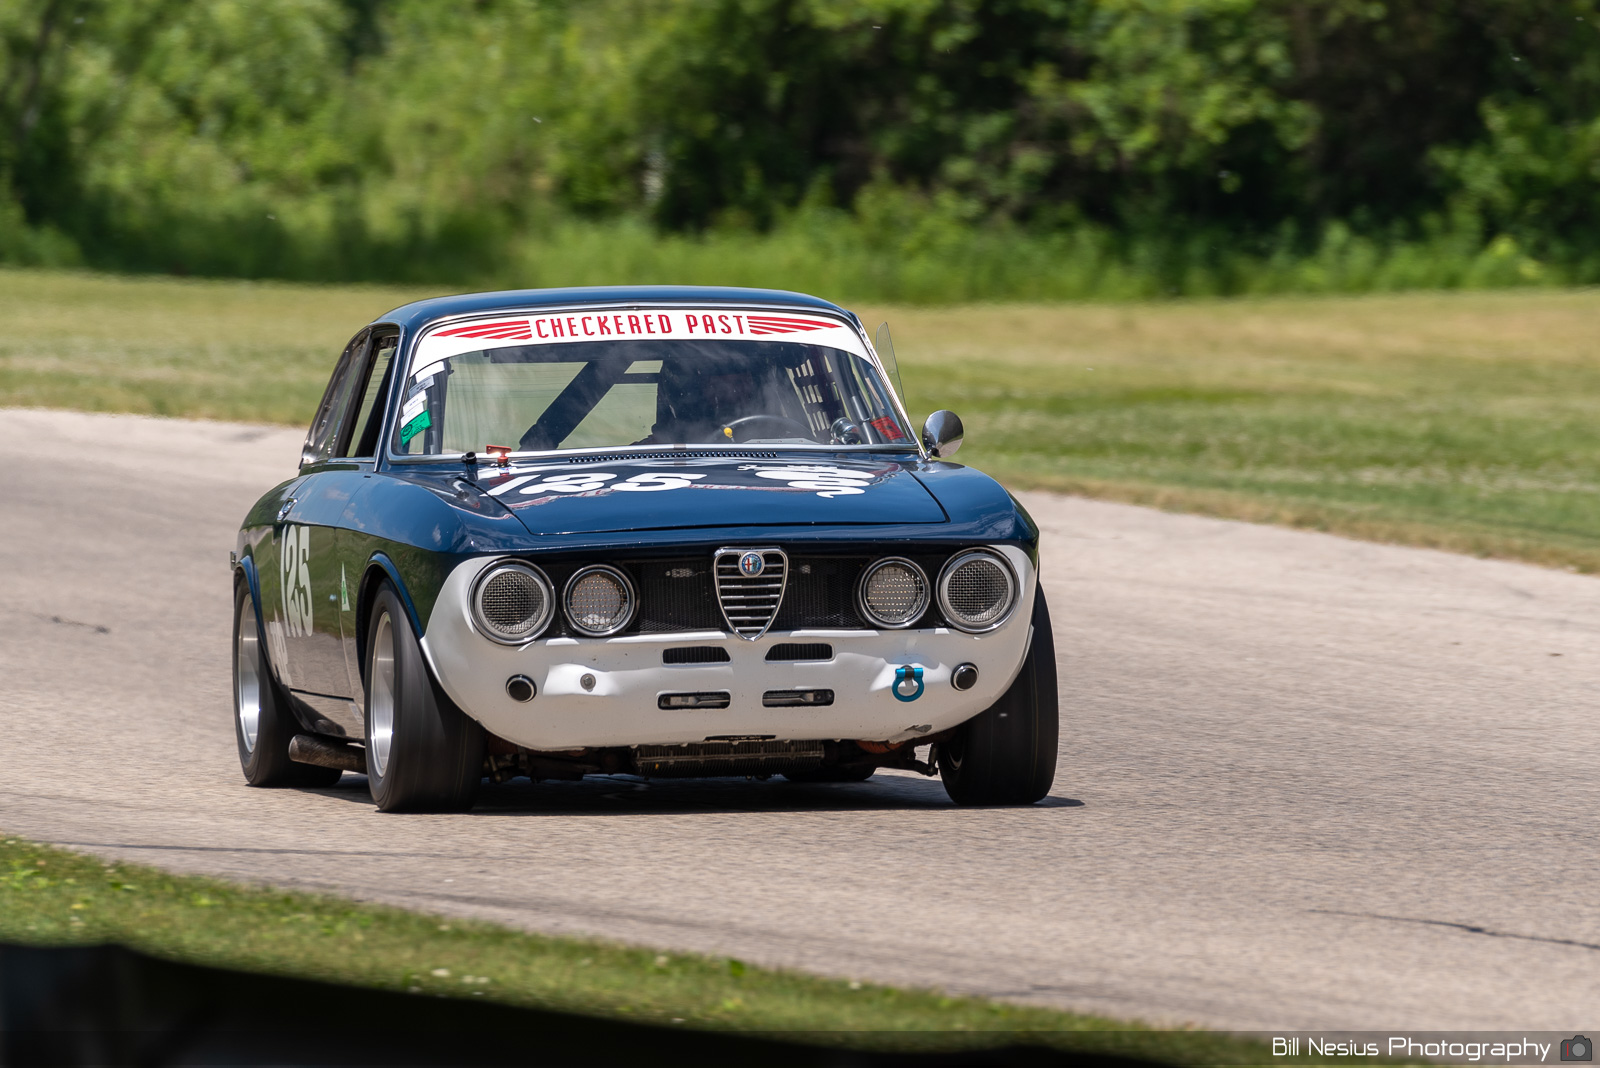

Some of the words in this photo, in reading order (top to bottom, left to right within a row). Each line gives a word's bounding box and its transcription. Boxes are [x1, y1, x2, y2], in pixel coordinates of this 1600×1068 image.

[535, 314, 673, 340] CHECKERED
[686, 314, 744, 335] PAST
[479, 472, 708, 497] 125
[280, 524, 314, 637] 125
